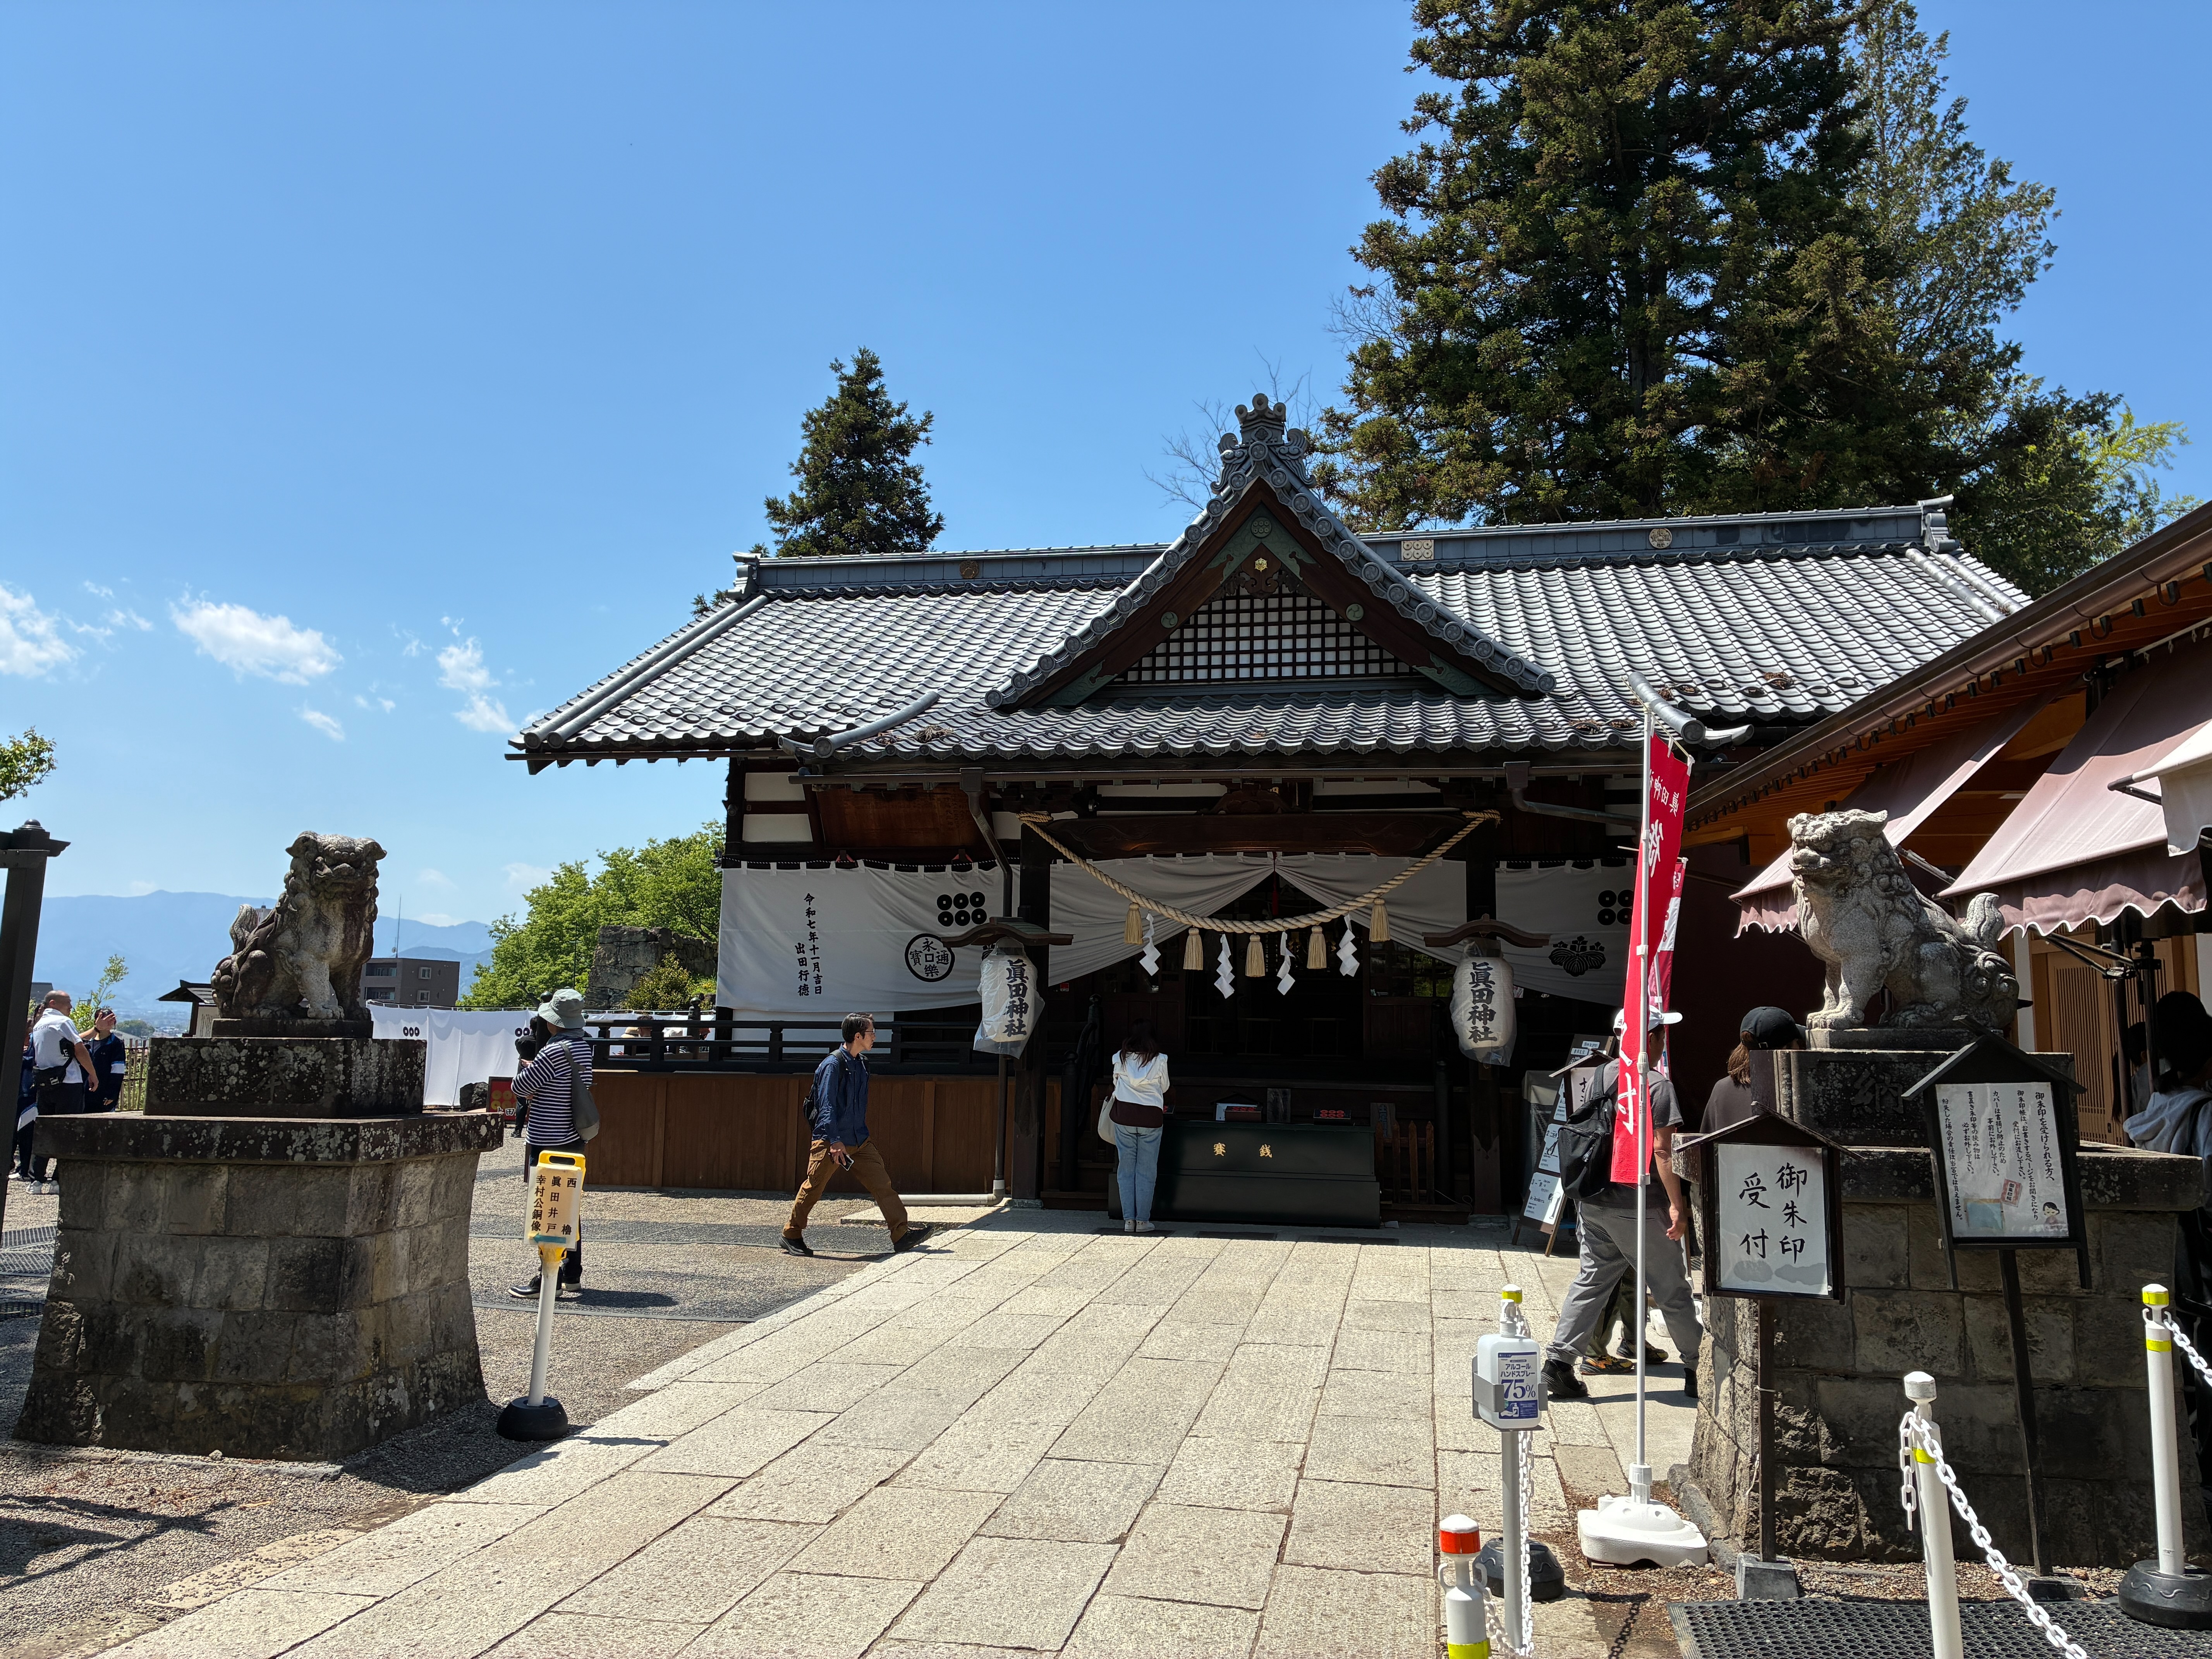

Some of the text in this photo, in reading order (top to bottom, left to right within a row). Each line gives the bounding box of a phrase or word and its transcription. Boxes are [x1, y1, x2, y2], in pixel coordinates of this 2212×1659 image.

[794, 942, 810, 997] 出田行徳
[804, 893, 823, 995] 令和七年十一月吉日
[2035, 1092, 2055, 1181] 御朱印を受けられる方へ
[531, 1175, 546, 1231] 幸村公銅像
[1739, 1172, 1771, 1259] 受付
[1775, 1162, 1807, 1264] 御朱印
[1501, 1379, 1536, 1399] 75%
